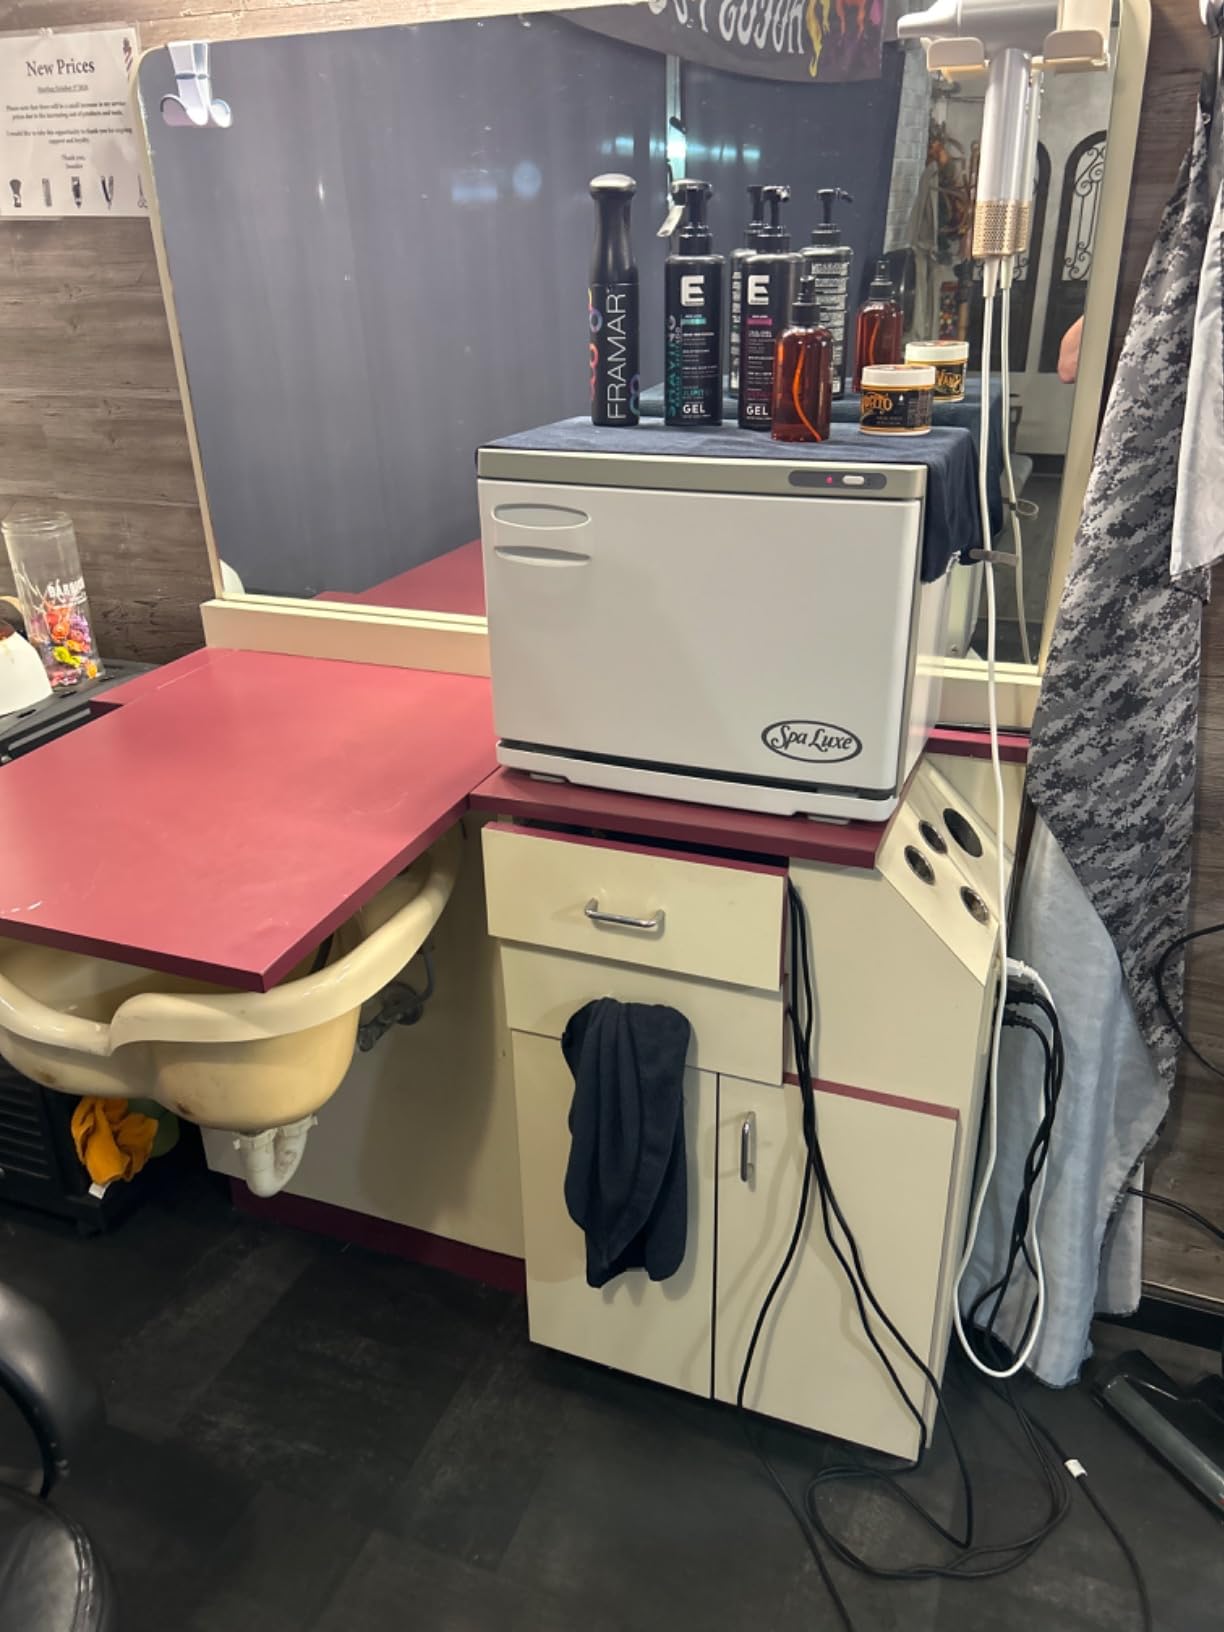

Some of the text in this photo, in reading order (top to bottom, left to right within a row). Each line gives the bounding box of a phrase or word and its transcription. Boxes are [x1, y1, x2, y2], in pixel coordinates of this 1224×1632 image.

[26, 58, 95, 77] New Prices
[681, 275, 704, 307] E
[748, 275, 769, 305] E
[607, 294, 626, 418] FRAMAR
[683, 404, 706, 414] GEL
[746, 405, 769, 416] GEL
[771, 725, 852, 753] Spa Luxe
